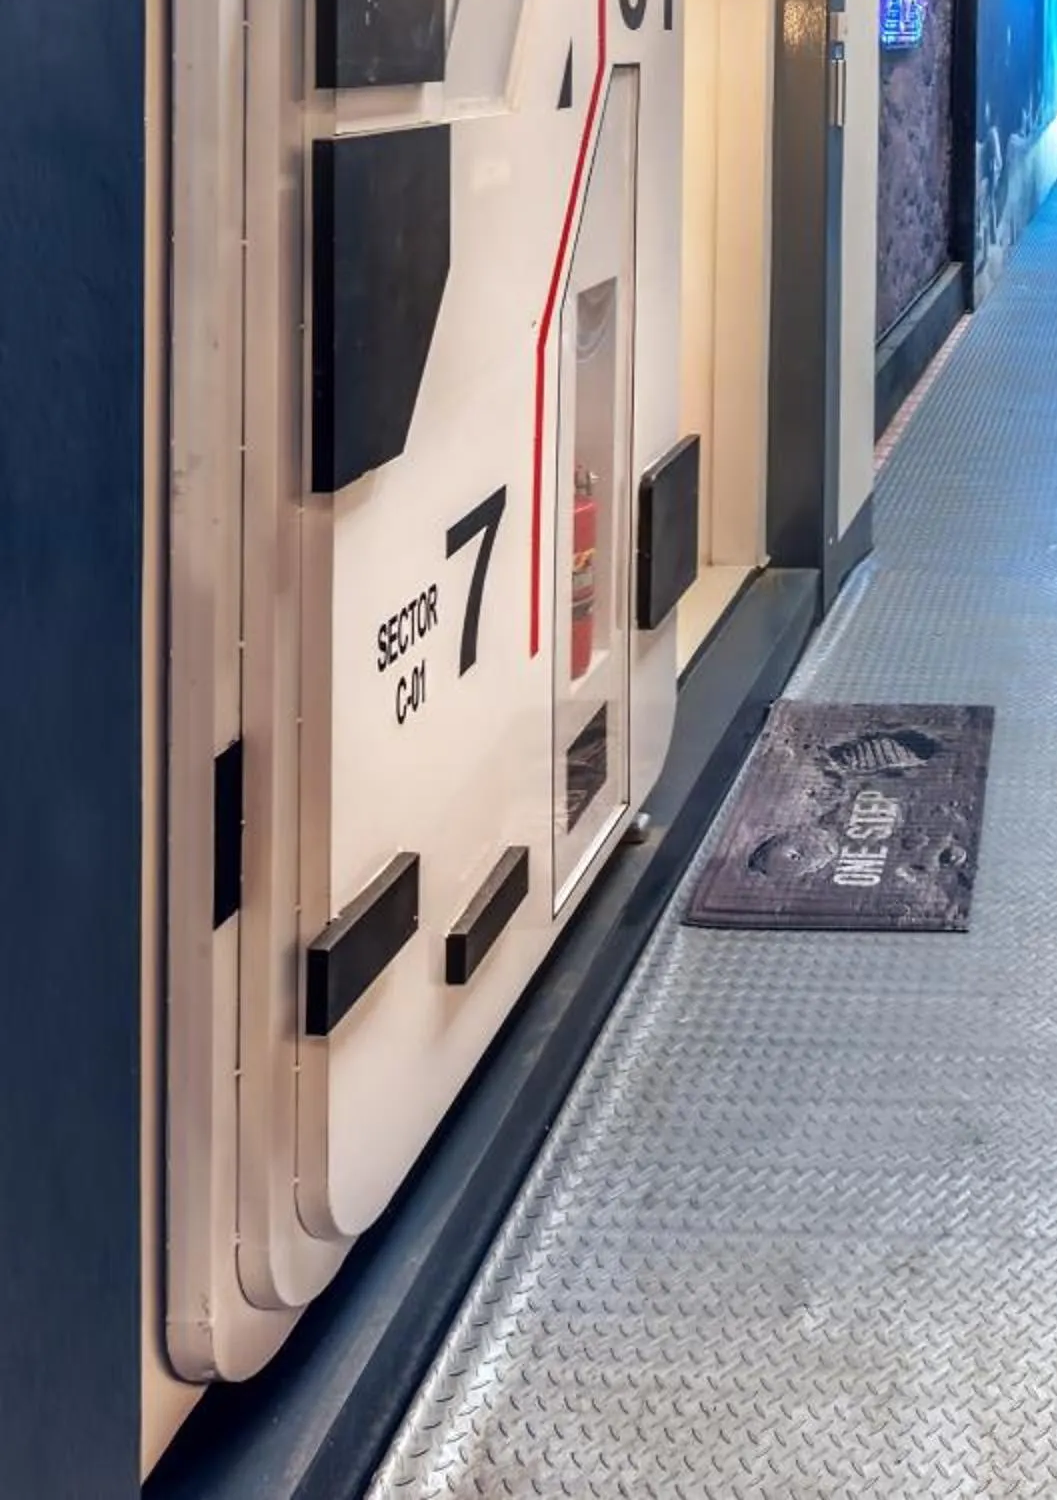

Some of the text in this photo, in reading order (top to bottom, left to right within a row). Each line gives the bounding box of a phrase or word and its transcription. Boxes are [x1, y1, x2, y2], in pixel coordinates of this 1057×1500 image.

[446, 485, 506, 677] 7
[377, 583, 437, 672] SECTOR
[396, 660, 426, 724] C-01
[833, 791, 898, 886] ONE STEP
